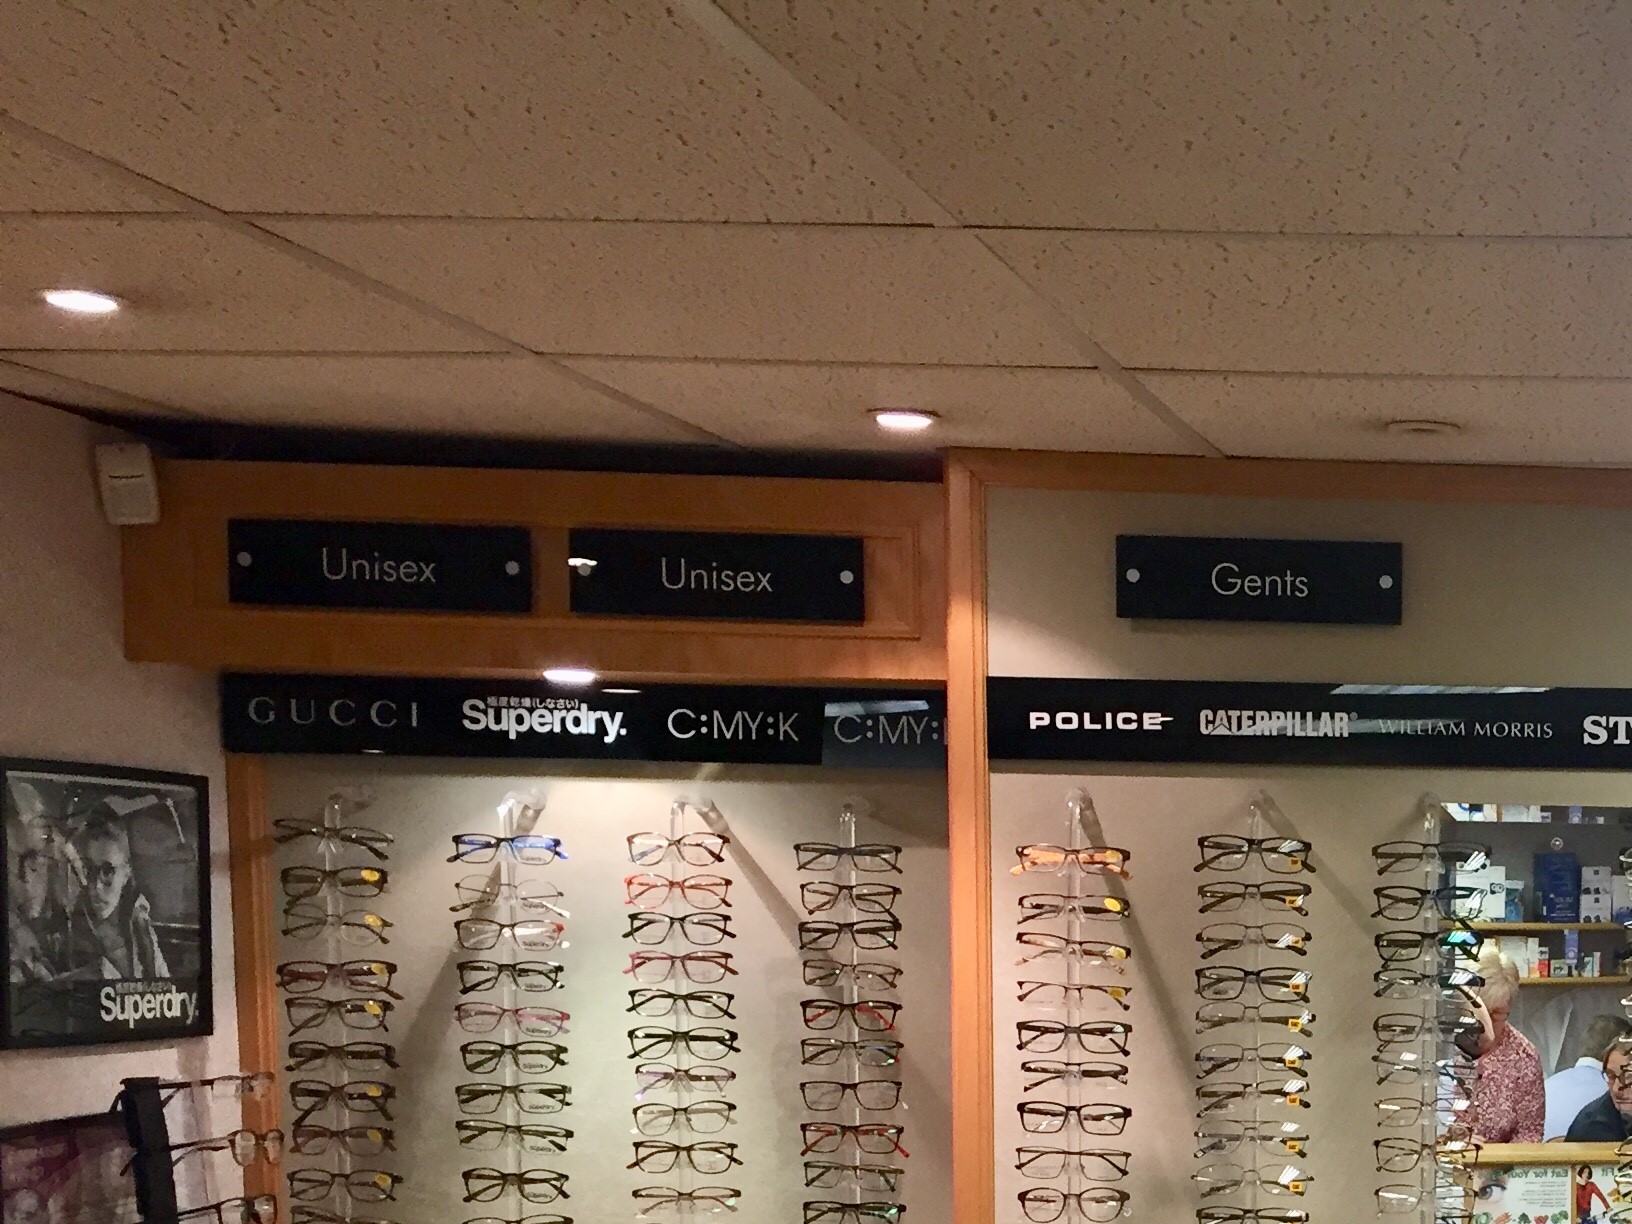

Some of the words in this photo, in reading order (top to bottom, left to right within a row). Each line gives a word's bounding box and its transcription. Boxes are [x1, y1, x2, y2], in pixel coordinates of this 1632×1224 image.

[322, 547, 436, 583] Unisex
[661, 557, 773, 593] Unisex
[1211, 562, 1310, 599] Gents
[248, 696, 418, 728] GUCCI
[1029, 711, 1174, 730] POLICE
[1200, 709, 1350, 738] CATERPILLAR
[834, 714, 948, 745] C:MY:
[1379, 719, 1466, 736] WILLIAM
[1474, 721, 1553, 738] MORRIS
